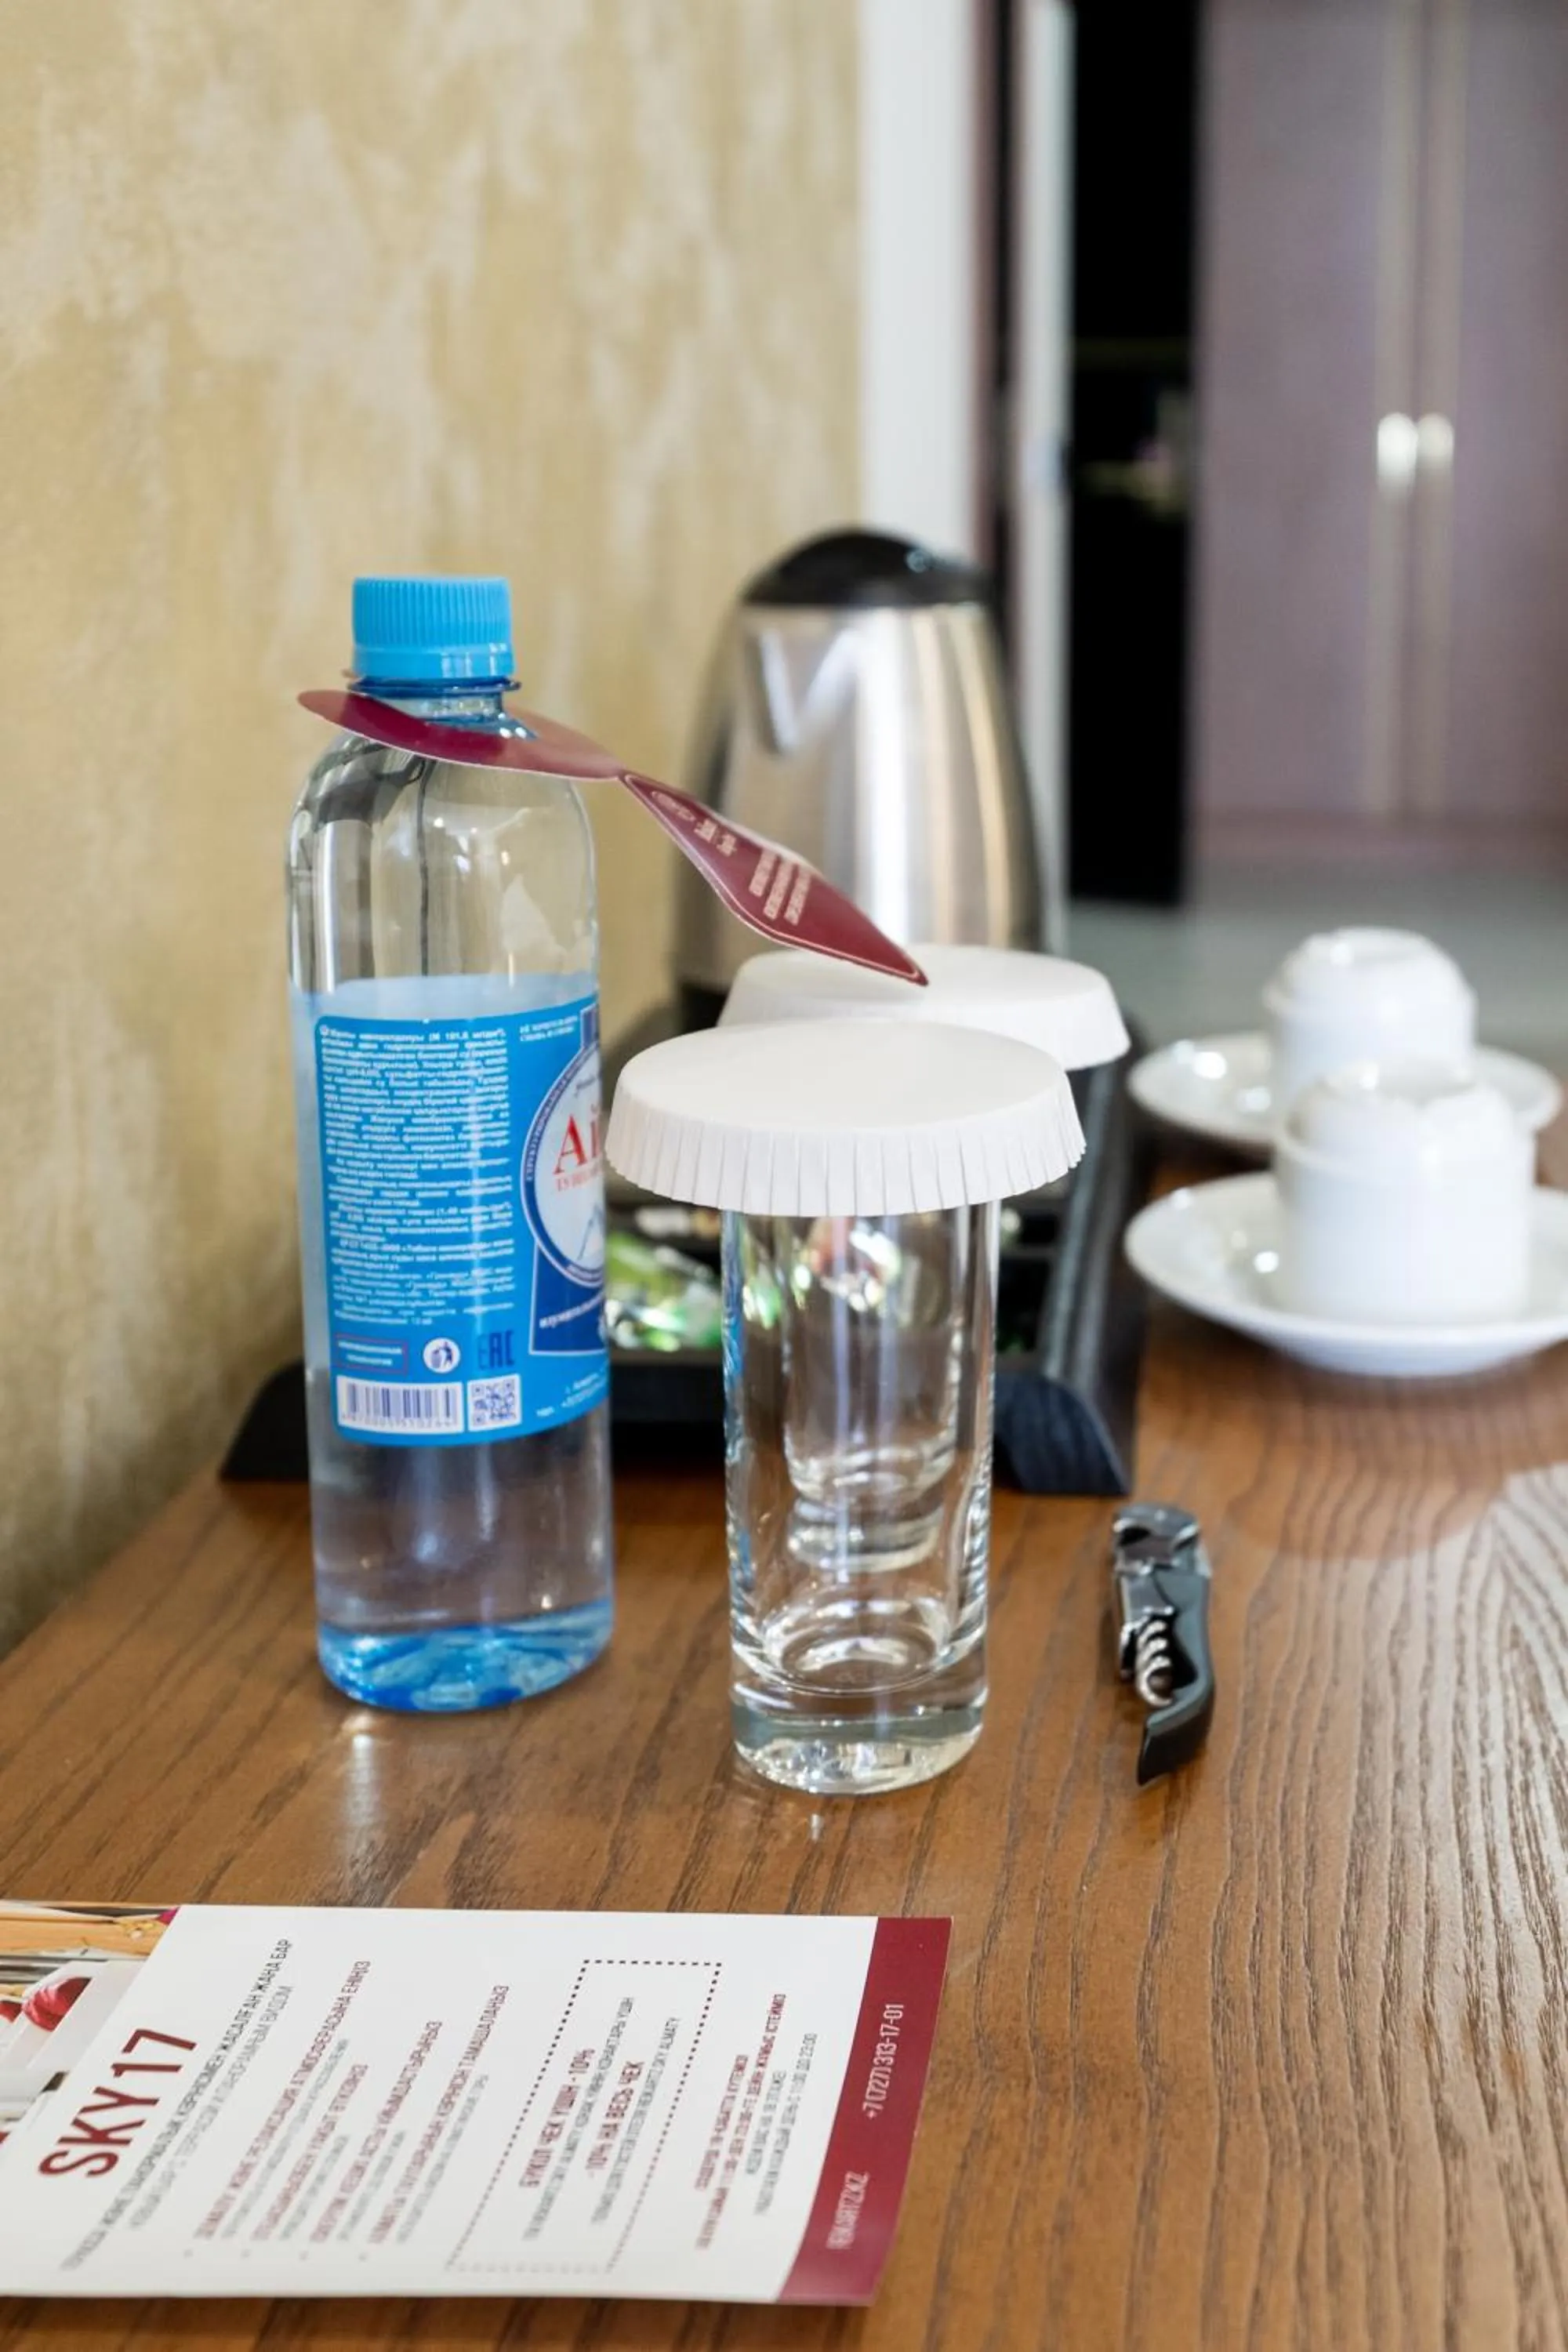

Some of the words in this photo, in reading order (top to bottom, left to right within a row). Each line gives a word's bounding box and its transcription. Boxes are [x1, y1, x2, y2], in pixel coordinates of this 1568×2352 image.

[214, 1994, 263, 2052] ЖАСАЛҒАН
[250, 1962, 281, 1992] ЖАҢА
[270, 1938, 295, 1958] БАР
[259, 1985, 295, 2021] ВИДОМ
[288, 1995, 353, 2085] АТМОСФЕРАСЫНА
[339, 1960, 373, 1993] ЕНІҢІЗ
[459, 1984, 510, 2067] ТАМАШАЛАҢЫЗ
[657, 2017, 680, 2050] ALMATY
[873, 2003, 905, 2065] 313-17-01
[799, 2032, 818, 2056] 23:00
[617, 2060, 644, 2085] ЧЕК
[864, 2066, 891, 2100] (727)
[38, 2085, 162, 2176] SKY
[111, 2027, 199, 2078] 17
[603, 2087, 634, 2119] ВЕСЬ
[860, 2101, 884, 2118] +7
[536, 2117, 567, 2146] ЧЕК
